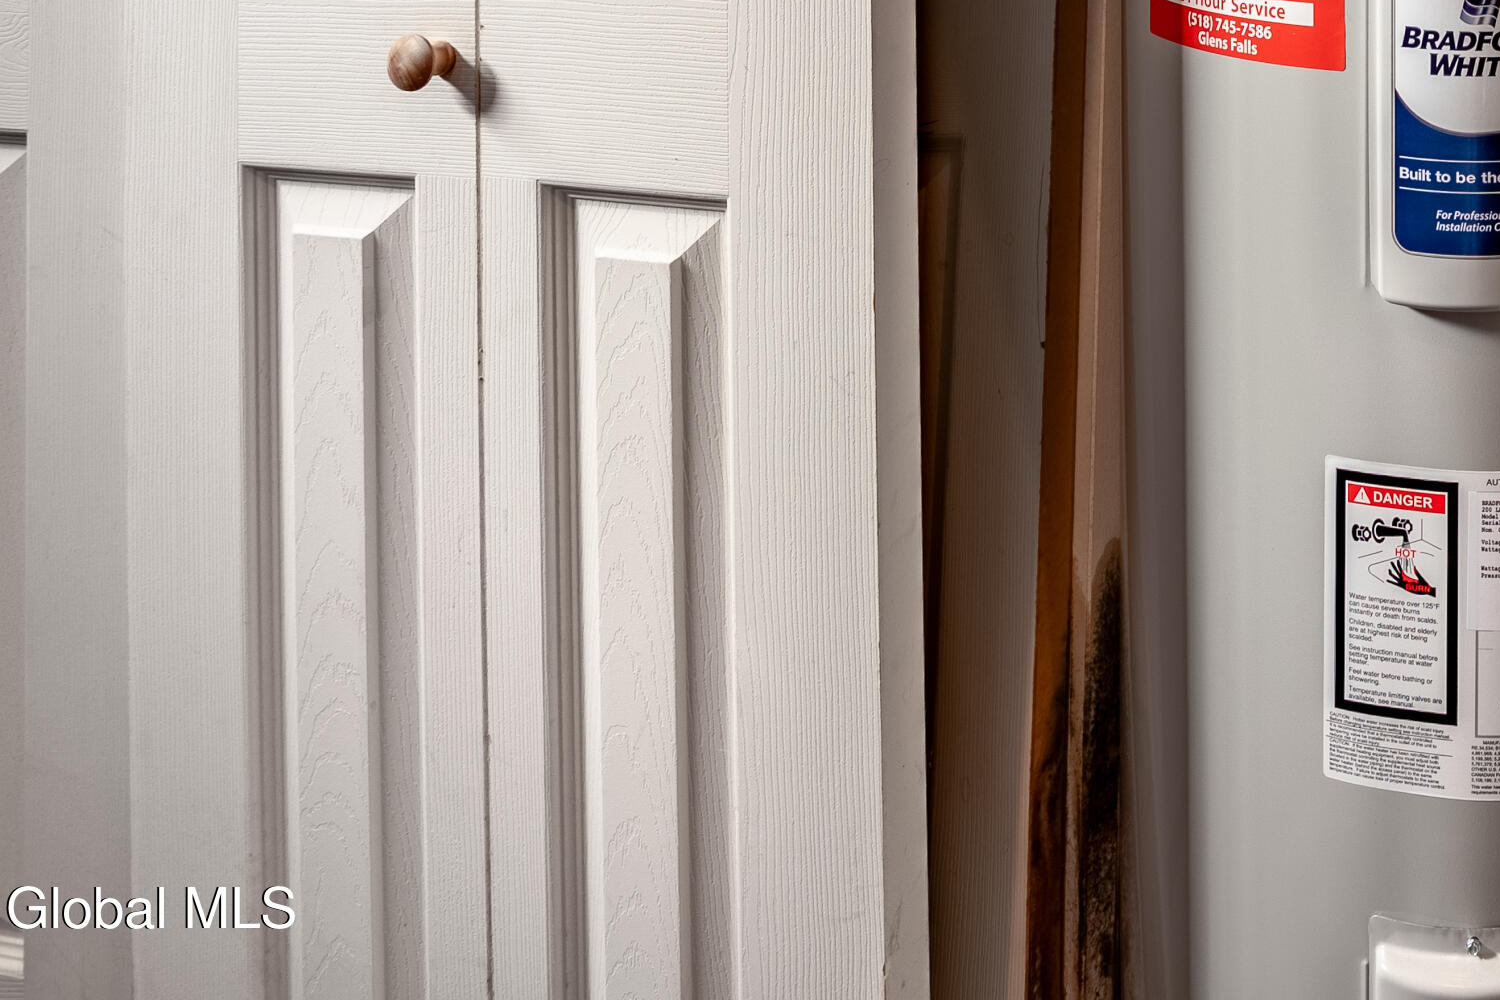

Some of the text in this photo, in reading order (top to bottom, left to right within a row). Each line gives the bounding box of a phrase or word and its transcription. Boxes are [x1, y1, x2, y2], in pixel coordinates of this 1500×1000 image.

[1187, 11, 1272, 40] (518) 745-7586
[1198, 31, 1258, 55] Glens Falls
[1399, 166, 1431, 182] Built
[1435, 169, 1451, 183] to
[1455, 169, 1476, 184] be
[1435, 209, 1452, 220] For
[1435, 221, 1492, 233] Installation
[1373, 491, 1433, 509] DANGER
[1395, 548, 1416, 558] HOT
[1405, 583, 1431, 593] BURN
[1349, 592, 1367, 601] Water
[1368, 595, 1405, 606] temperature
[1349, 607, 1374, 617] instantly
[1382, 612, 1400, 620] death
[1402, 614, 1416, 622] from
[1417, 616, 1438, 624] scalds.
[1361, 602, 1379, 610] cause
[1381, 604, 1401, 612] severe
[1402, 606, 1420, 615] burns
[1367, 628, 1389, 638] highest
[1391, 631, 1402, 639] risk
[1403, 632, 1410, 640] of
[1410, 633, 1428, 643] being
[1377, 622, 1402, 631] disabled
[1404, 625, 1416, 633] and
[1417, 627, 1437, 637] elderly
[1349, 643, 1438, 662] See instruction manual before
[1349, 651, 1368, 660] setting
[1370, 653, 1407, 665] temperature
[1349, 667, 1362, 675] Feel
[1381, 671, 1400, 680] before
[1402, 674, 1425, 685] bathing
[1349, 685, 1387, 697] Temperature
[1388, 690, 1410, 701] limiting
[1411, 695, 1431, 703] valves
